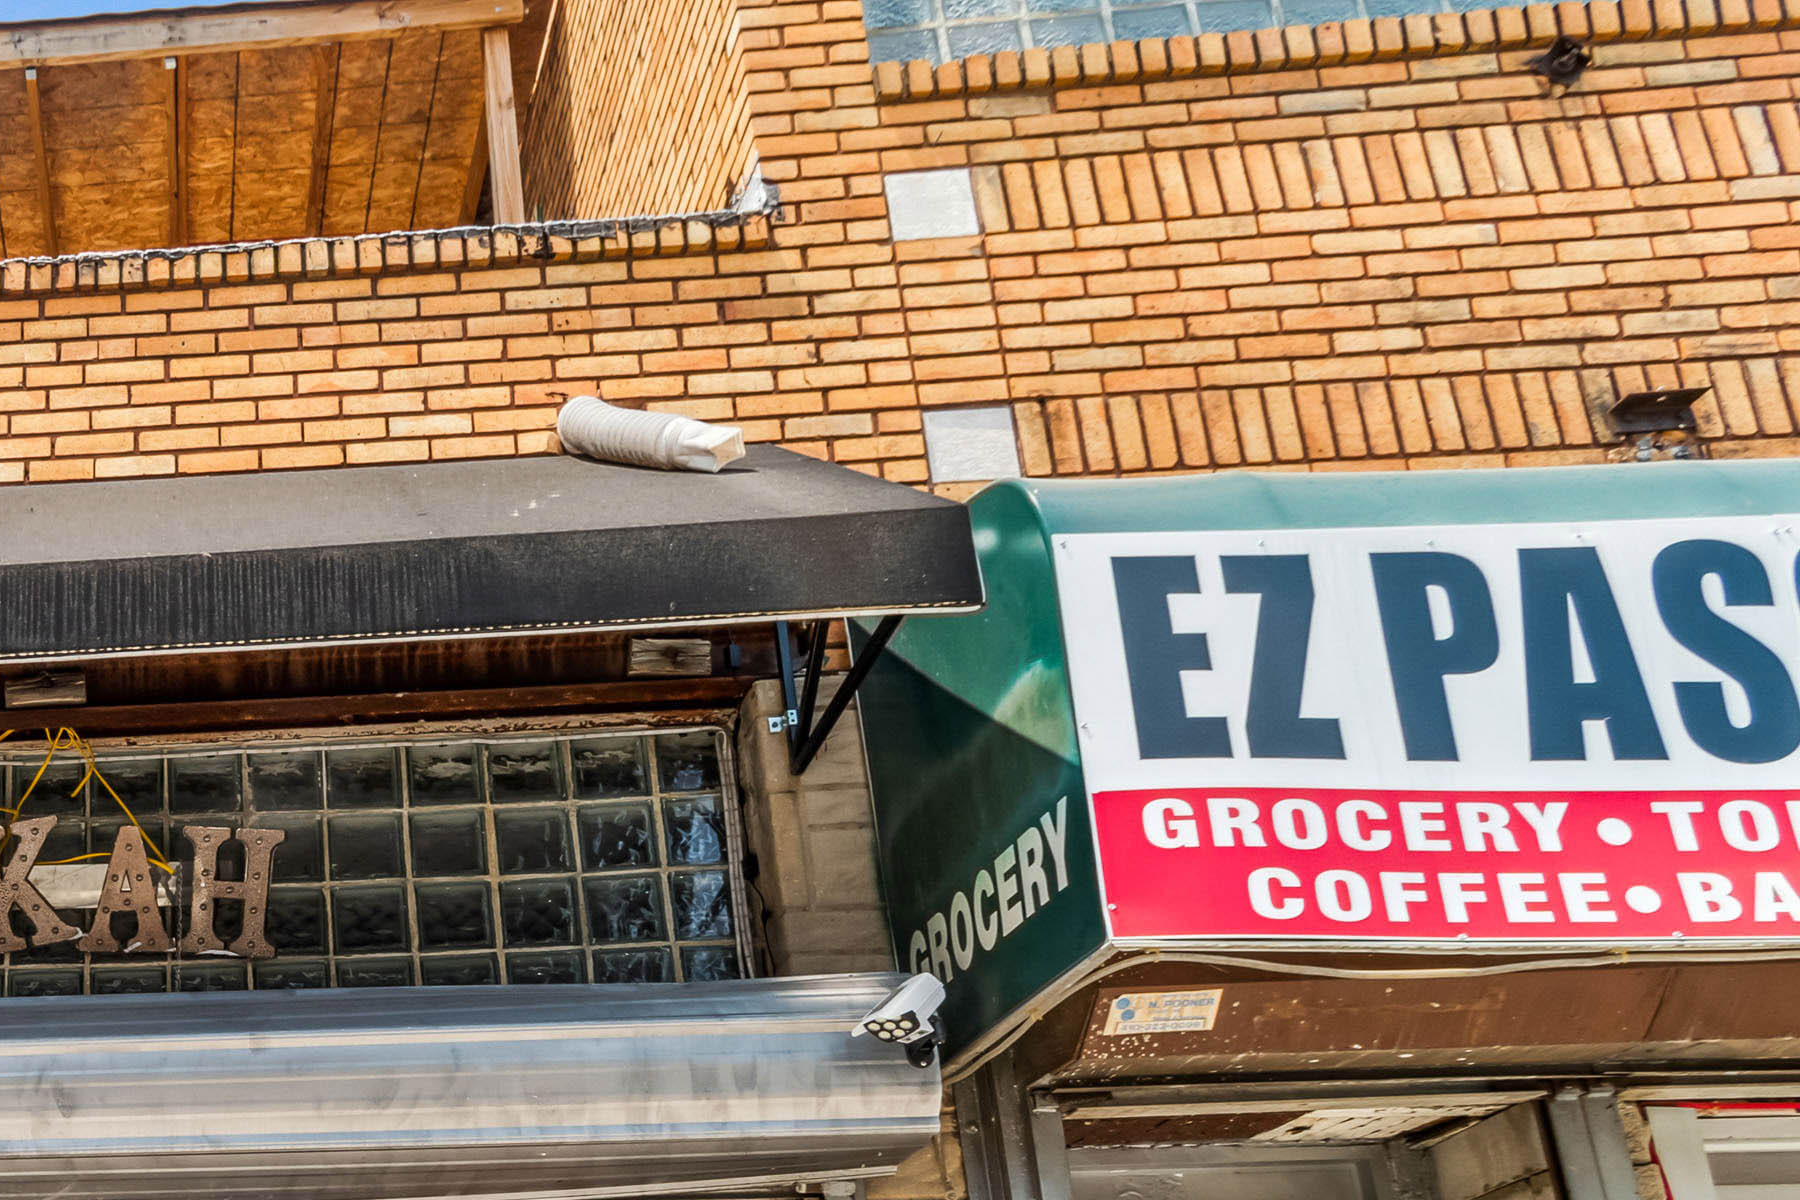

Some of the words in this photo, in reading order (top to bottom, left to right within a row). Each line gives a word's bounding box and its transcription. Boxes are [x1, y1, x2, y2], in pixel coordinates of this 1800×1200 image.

[1111, 554, 1346, 761] EZ
[1370, 538, 1800, 765] PAS
[1141, 797, 1569, 854] GROCERY
[909, 795, 1069, 984] GROCERY
[1247, 866, 1619, 925] COFFEE
